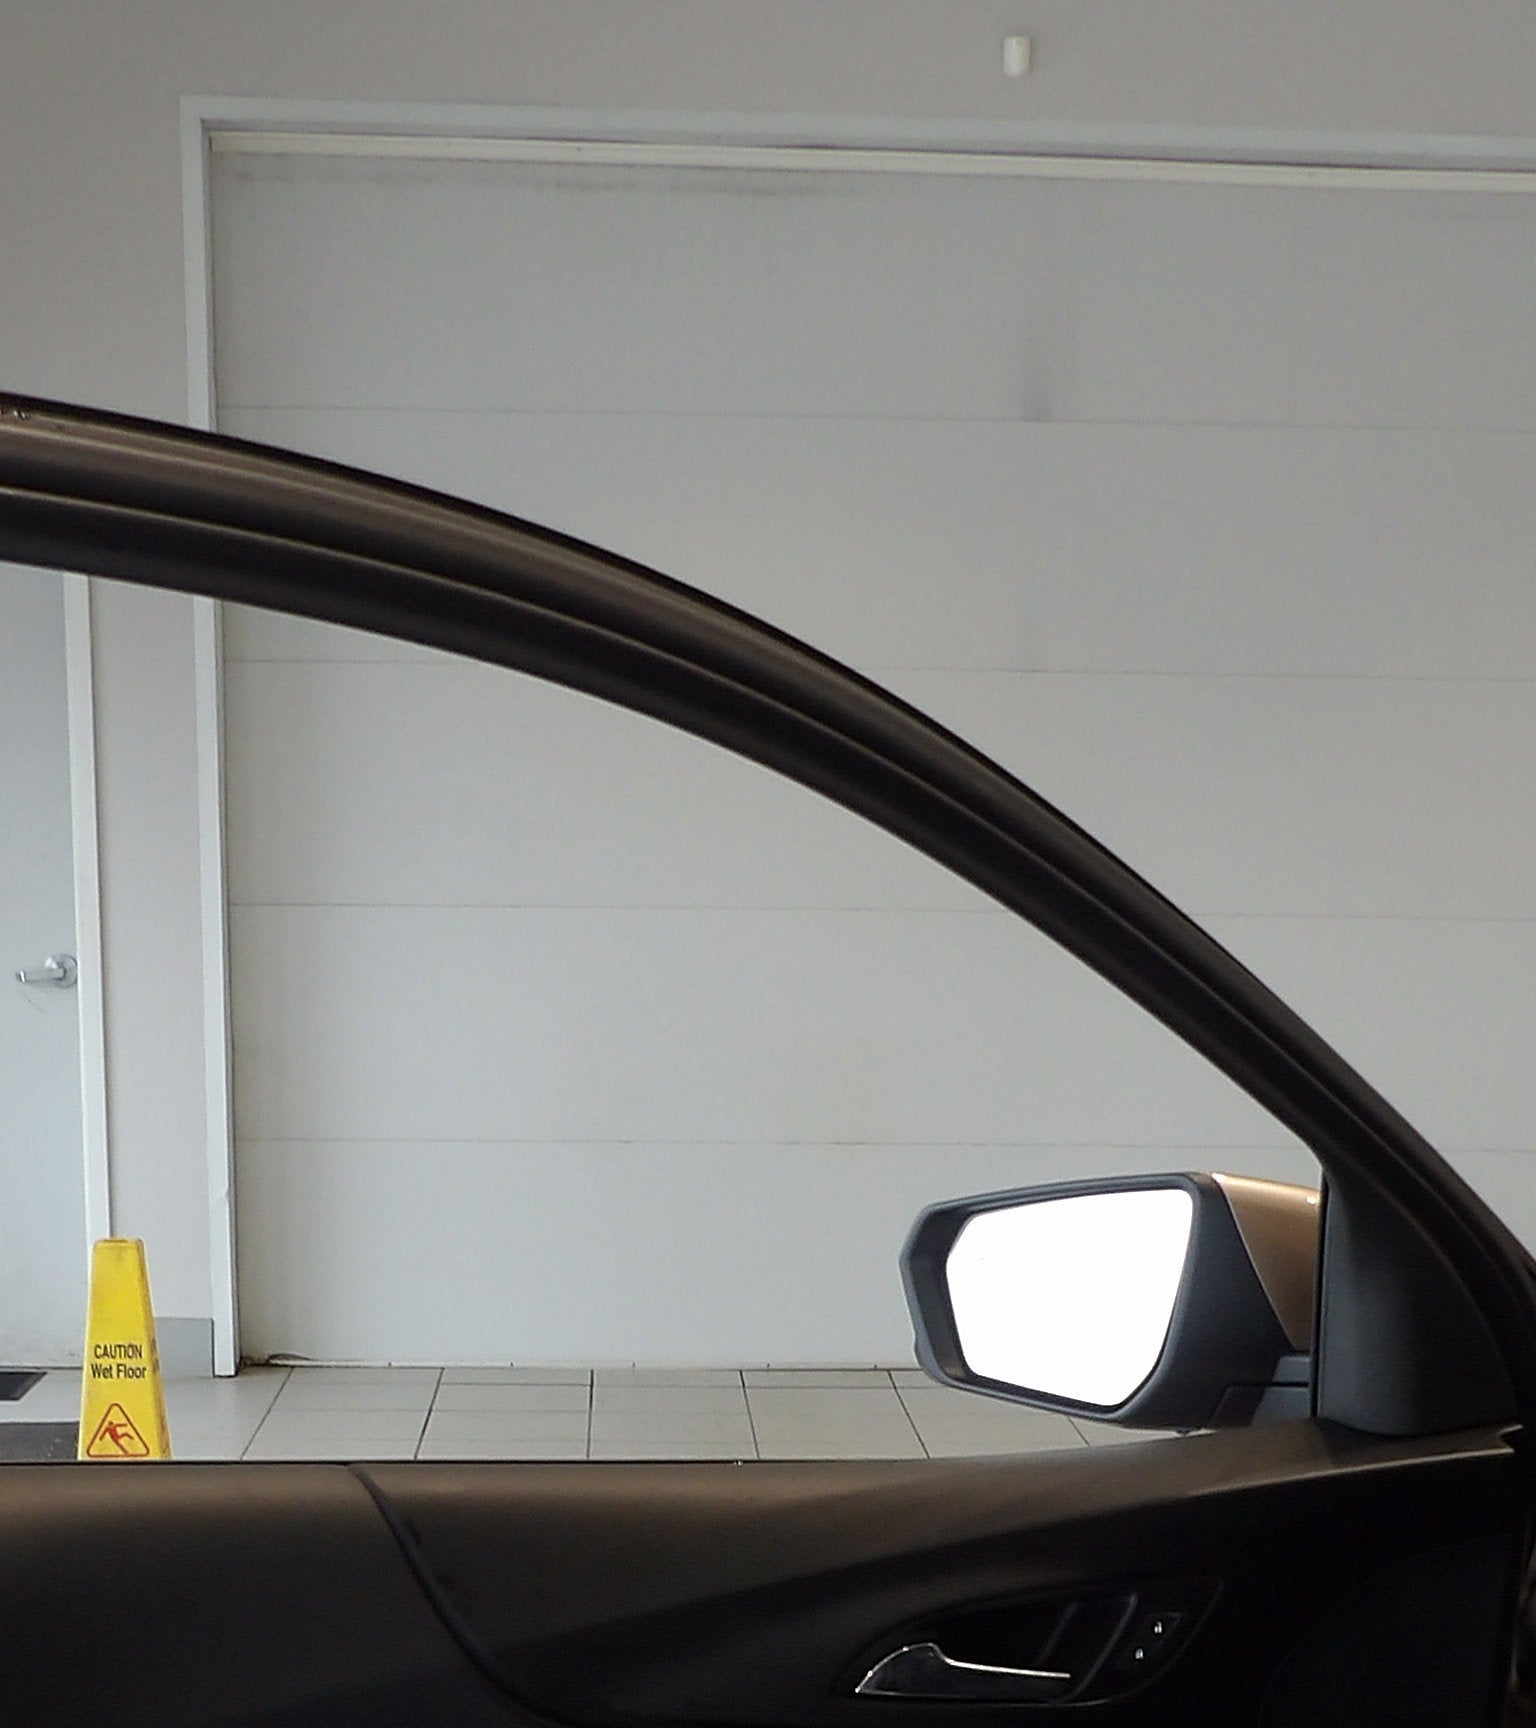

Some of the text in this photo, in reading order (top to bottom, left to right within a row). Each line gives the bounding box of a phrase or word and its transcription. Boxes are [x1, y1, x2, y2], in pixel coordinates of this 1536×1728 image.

[94, 1343, 143, 1360] CAUTION
[90, 1362, 147, 1379] Wet Floor
